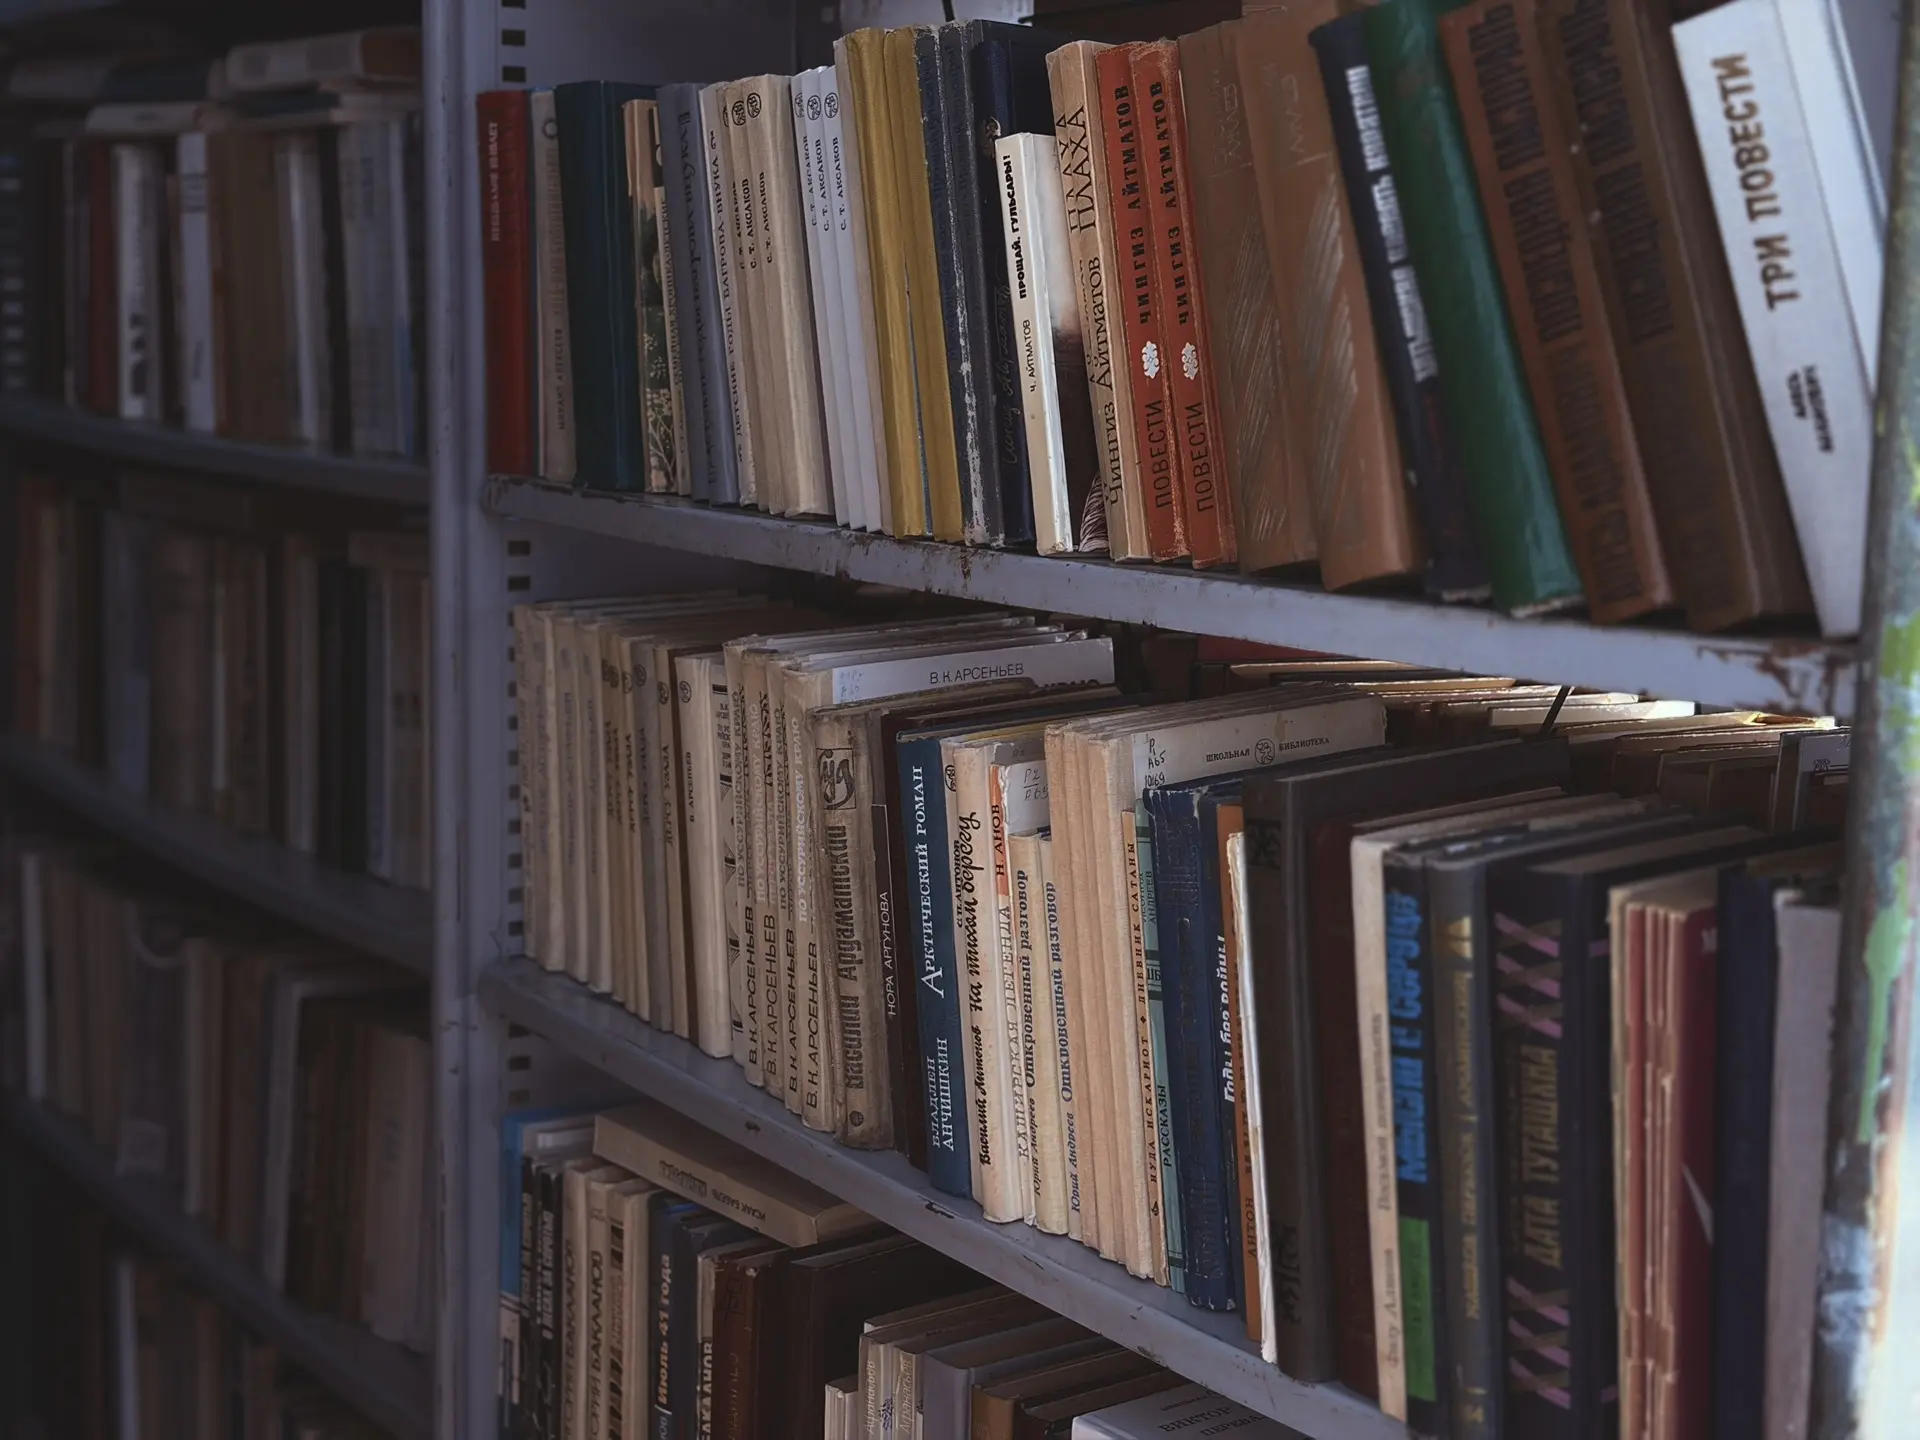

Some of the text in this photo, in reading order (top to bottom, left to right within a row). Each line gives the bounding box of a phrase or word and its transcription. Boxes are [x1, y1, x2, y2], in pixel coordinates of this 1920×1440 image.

[1466, 2, 1547, 174] ПАСТОРАЛЬ
[741, 177, 755, 237] АКСАКОВ
[758, 171, 771, 231] АКСАКОВ
[814, 137, 827, 199] АКСАКОВ
[831, 136, 845, 198] АКСАКОВ
[1003, 153, 1020, 234] ГУЛЬСАРЫ!
[1066, 105, 1097, 234] ПЛАХА
[1709, 52, 1801, 311] ТРИ ПОВЕСТИ
[1113, 84, 1174, 509] ПОВЕСТИ ЧИНГИЗ АЙТМАТОВ
[1501, 165, 1583, 345] ПОСЛЕДНЯЯ
[711, 156, 743, 438] ДЕТСКИЕ ГОДЫ БАГРОВА-ВНУКА
[1086, 256, 1114, 392] Айтматов
[1149, 81, 1215, 513] ПОВЕСТИ ЧИНГИЗ АЙТМАТОВ
[1022, 318, 1037, 378] АЙТМАТОВ
[1028, 380, 1038, 393] Ч.
[1105, 401, 1124, 505] Чингиз
[929, 662, 1025, 684] В. К. АРСЕНЬЕВ
[686, 751, 694, 808] АРСЕНЬЕВ
[1205, 736, 1330, 763] ШКОЛЬНАЯ БИБЛИОТЕКА
[661, 743, 674, 847] ДЕРСУ УЗАЛА
[911, 765, 928, 836] РОМАН
[953, 839, 963, 901] АНТОНОВ
[992, 804, 1005, 876] Н. АНОВ
[825, 824, 863, 982] Ардаматский
[1145, 870, 1157, 924] АНДРЕЕВ
[745, 905, 757, 1024] АРСЕНЬЕВ
[764, 914, 779, 1034] АРСЕНЬЕВ
[785, 928, 797, 1050] АРСЕНЬЕВ
[878, 891, 896, 1016] НОРА АРГУНОВА
[958, 811, 992, 1166] Василий Антонов На тихом берегу
[807, 941, 819, 1066] АРСЕНЬЕВ
[997, 904, 1031, 1159] КАШИРСКАЯ ЛЕГЕНДА
[1015, 869, 1042, 1197] Юрий Андреев Откровенный разговор
[1126, 841, 1158, 1185] ИУДА ИСКАРИОТ ДНЕВНИК САТАНЫ
[748, 1048, 758, 1065] В.
[766, 1057, 777, 1076] В.
[788, 1075, 798, 1093] В.
[807, 1070, 818, 1086] К.
[1043, 880, 1081, 1214] Юрий Андреев Откровенный разговор
[806, 1091, 818, 1109] В.
[926, 1056, 940, 1148] ВЛАДЛЕН
[936, 1037, 955, 1152] АНЧИШКИН
[1156, 1083, 1172, 1168] РАССКАЗЫ
[1244, 1196, 1258, 1259] АНТОН
[1518, 1195, 1563, 1268] ДАТА
[590, 1250, 604, 1373] БАКЛАНОВ
[658, 1253, 672, 1306] года
[657, 1310, 670, 1337] 41
[656, 1341, 671, 1406] Июль
[1157, 1406, 1233, 1433] ВИКТОР
